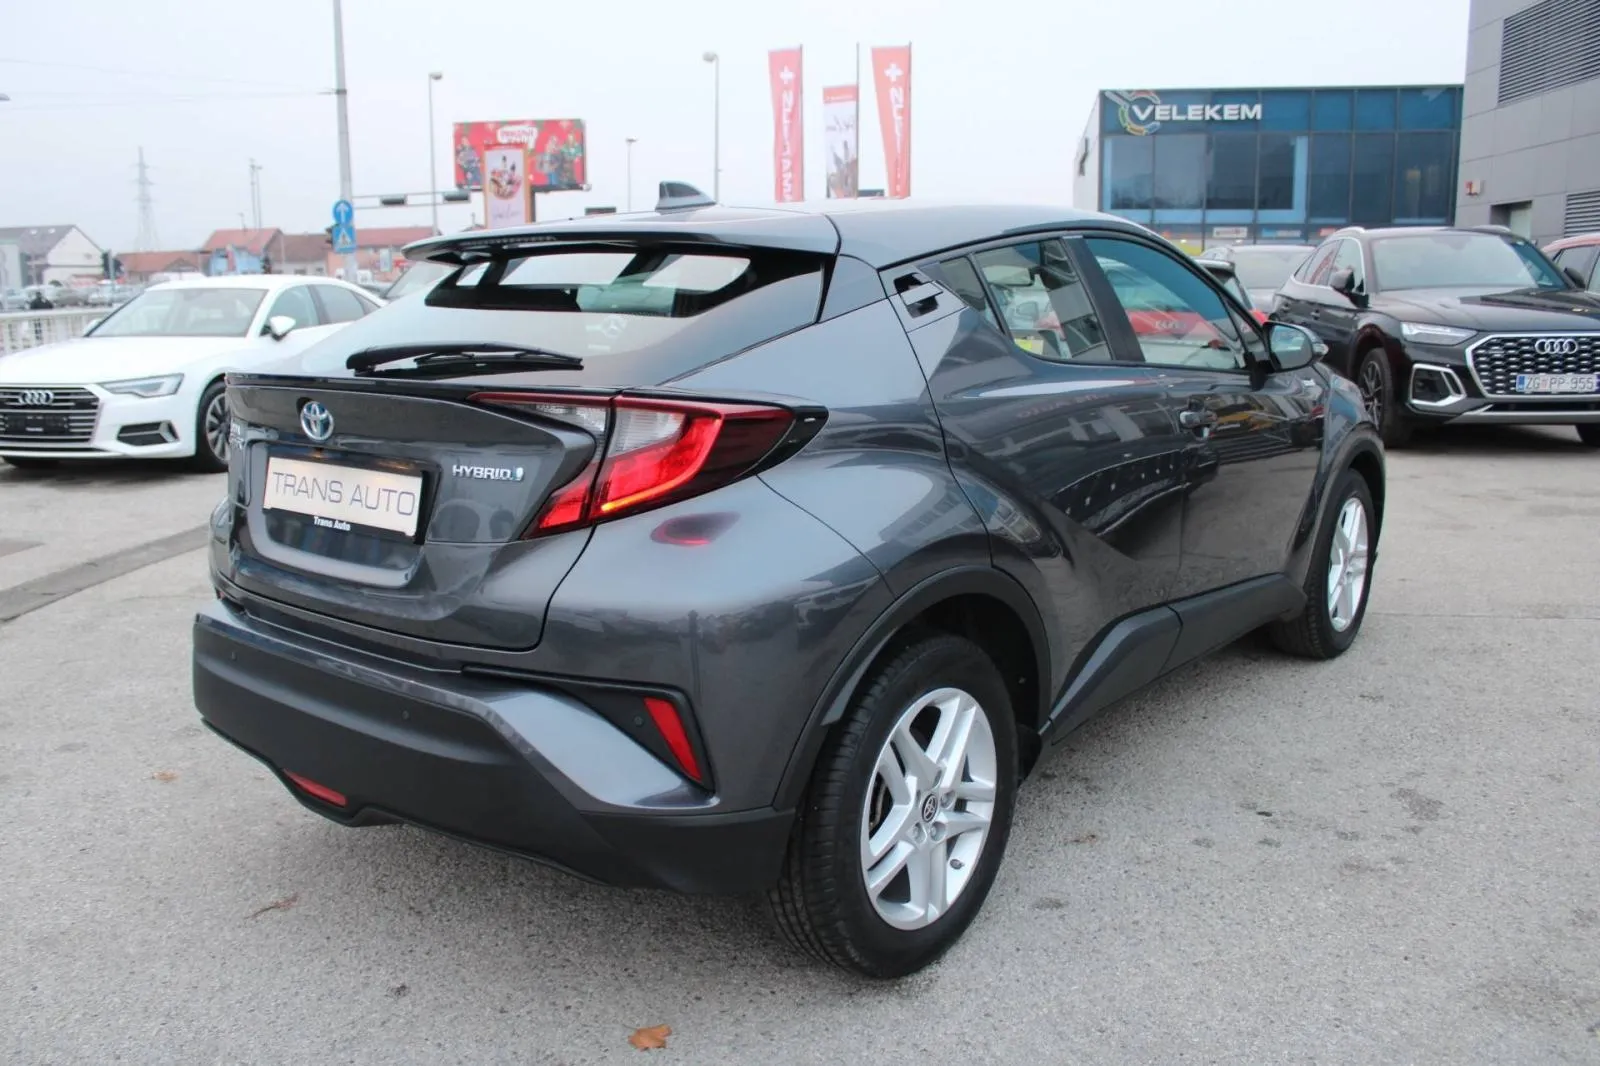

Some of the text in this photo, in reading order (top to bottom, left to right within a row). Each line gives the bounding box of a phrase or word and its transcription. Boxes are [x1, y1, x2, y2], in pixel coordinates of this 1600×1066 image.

[1131, 103, 1263, 122] VELEKEM
[1525, 376, 1541, 390] ZG
[451, 464, 511, 481] HYBRID
[272, 470, 416, 516] TRANS AUTO
[313, 515, 352, 532] Trans Auto
